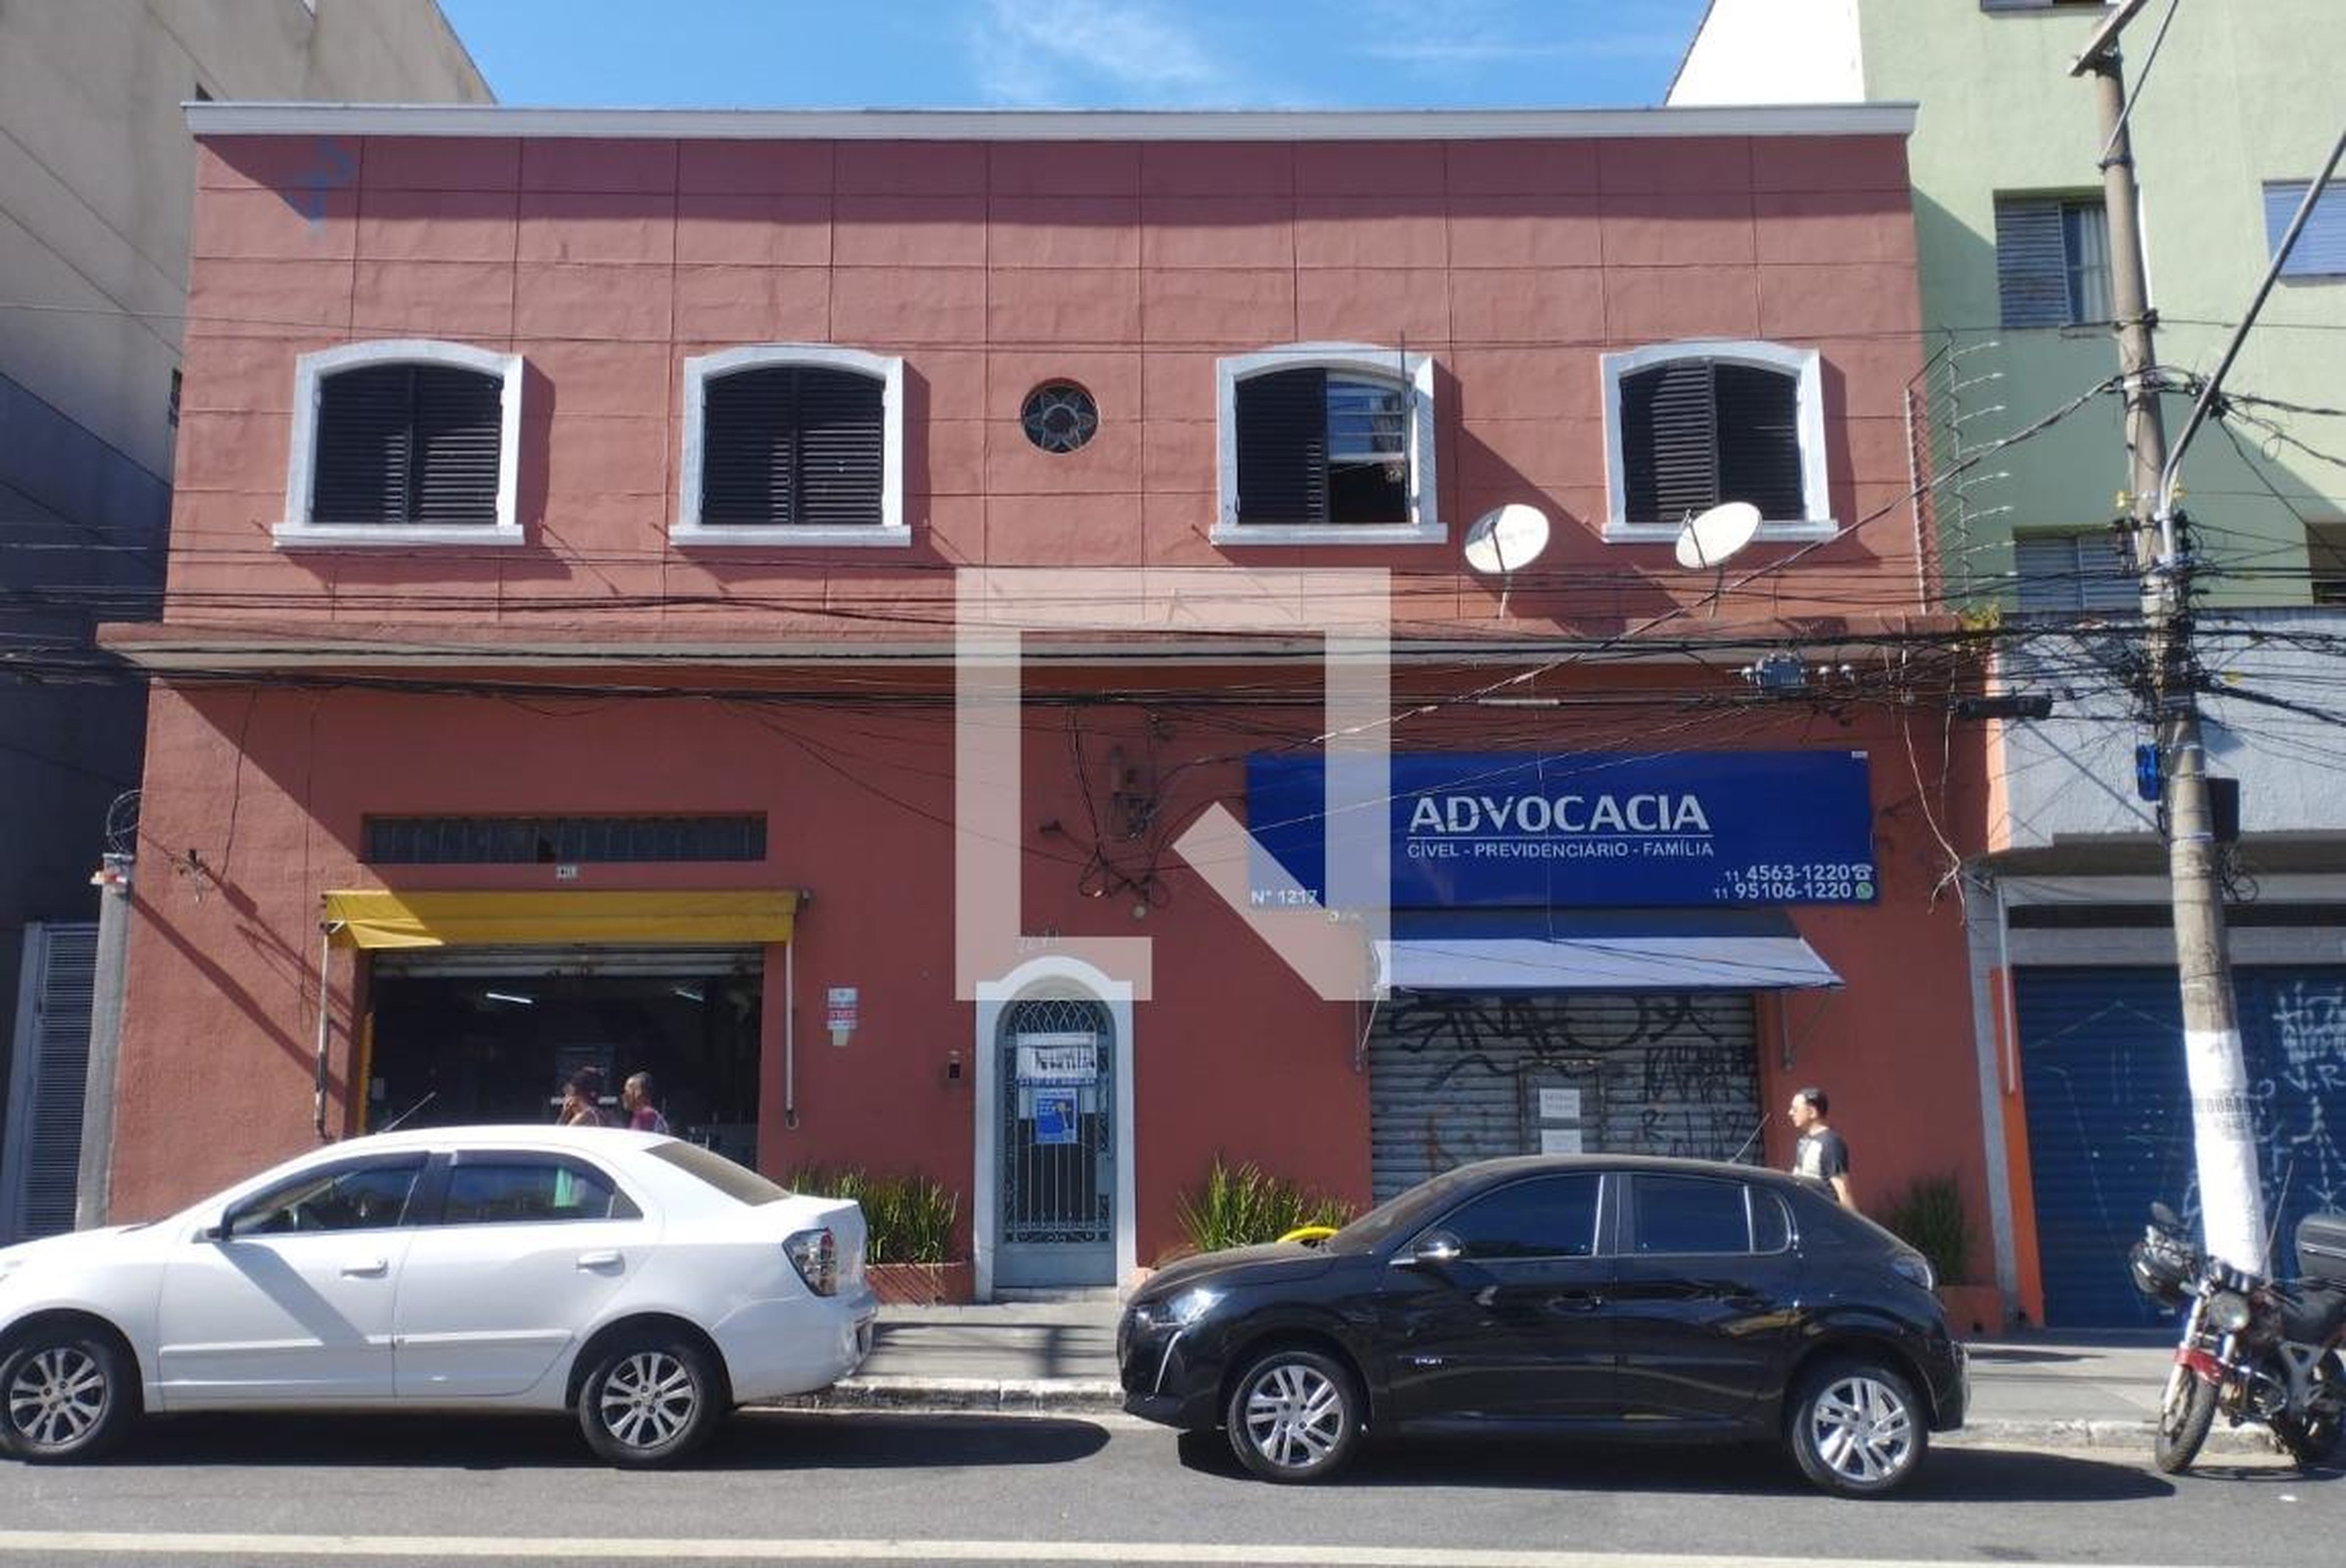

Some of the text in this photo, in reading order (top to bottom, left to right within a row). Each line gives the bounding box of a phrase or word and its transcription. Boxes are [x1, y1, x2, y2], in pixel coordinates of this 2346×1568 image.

[1409, 795, 1710, 832] ADVOCACIA
[1474, 839, 1629, 858] PREVIDENCIÁRIO
[1643, 839, 1714, 857] FAMÍLIA
[1725, 864, 1850, 882] 11 4563-1220
[1277, 889, 1318, 905] 1217
[1714, 883, 1851, 899] 11 95106-1220
